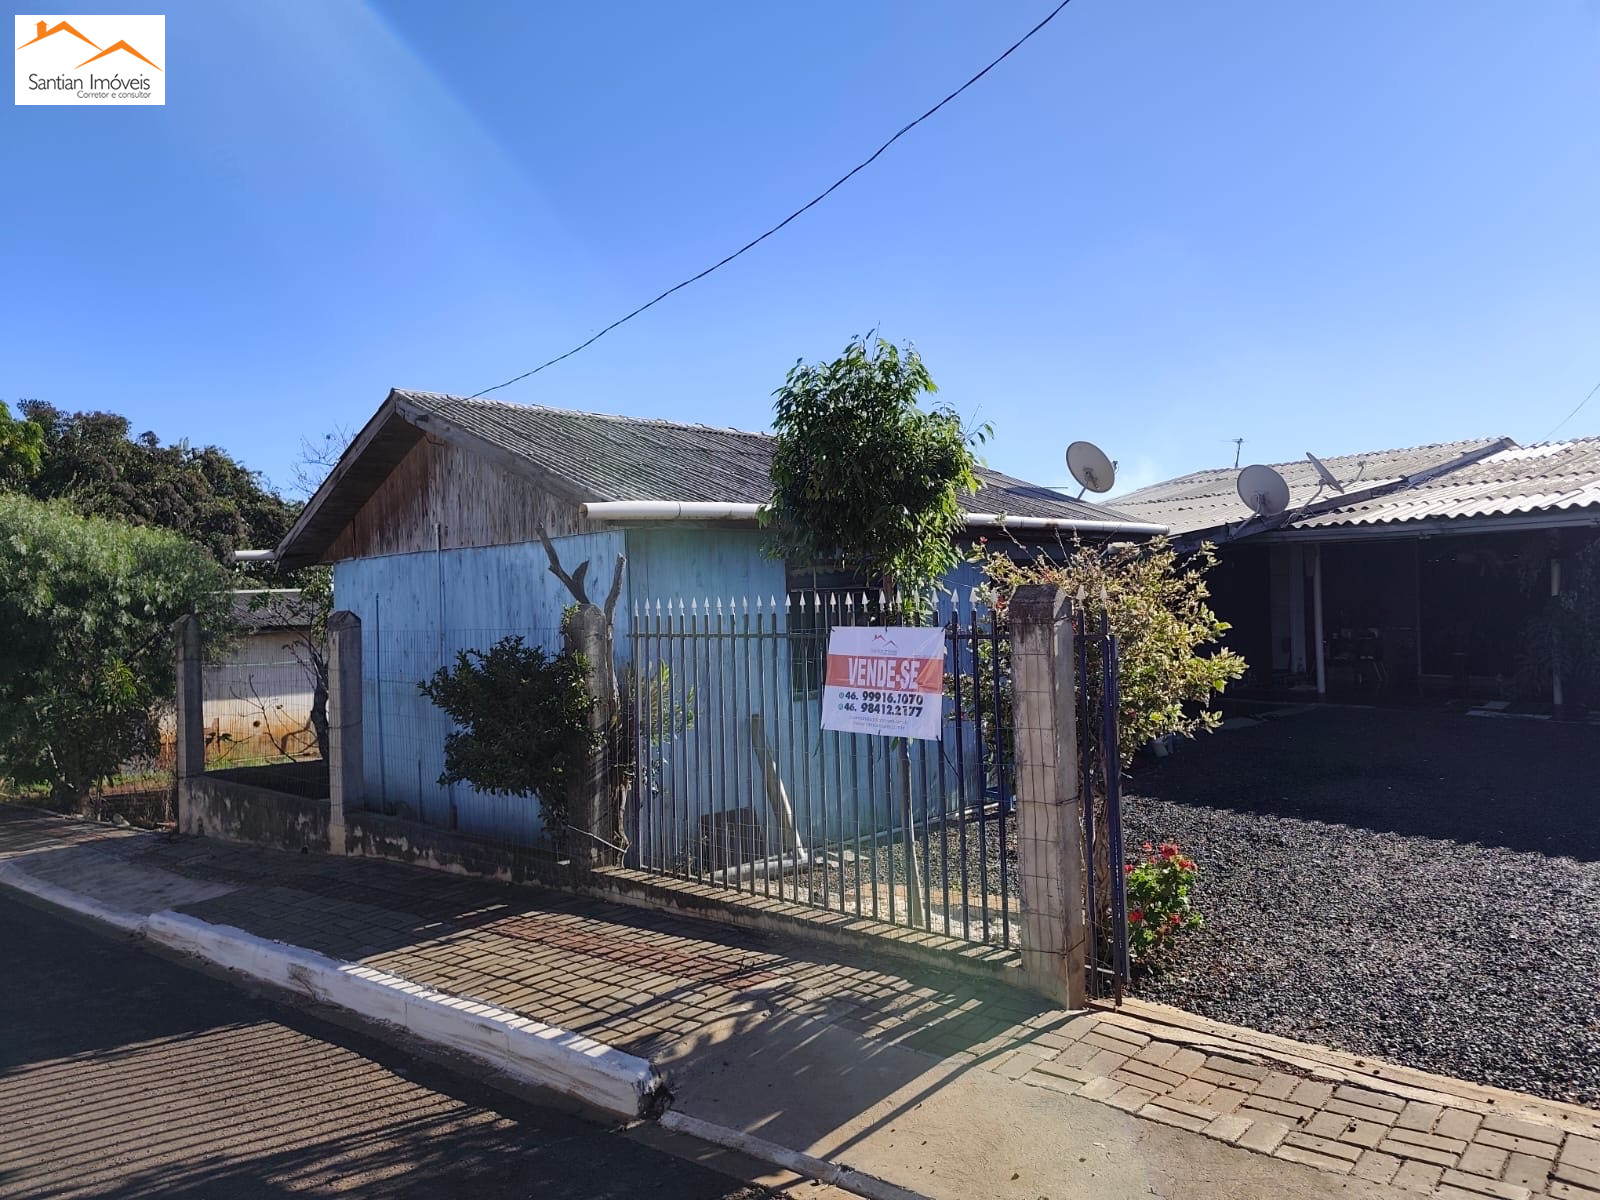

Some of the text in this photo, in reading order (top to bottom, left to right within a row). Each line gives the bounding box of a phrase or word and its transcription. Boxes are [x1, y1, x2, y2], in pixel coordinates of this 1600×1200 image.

[848, 657, 920, 690] VENDE-SE
[845, 691, 924, 705] 46. 99916.1070
[843, 702, 857, 712] 46.
